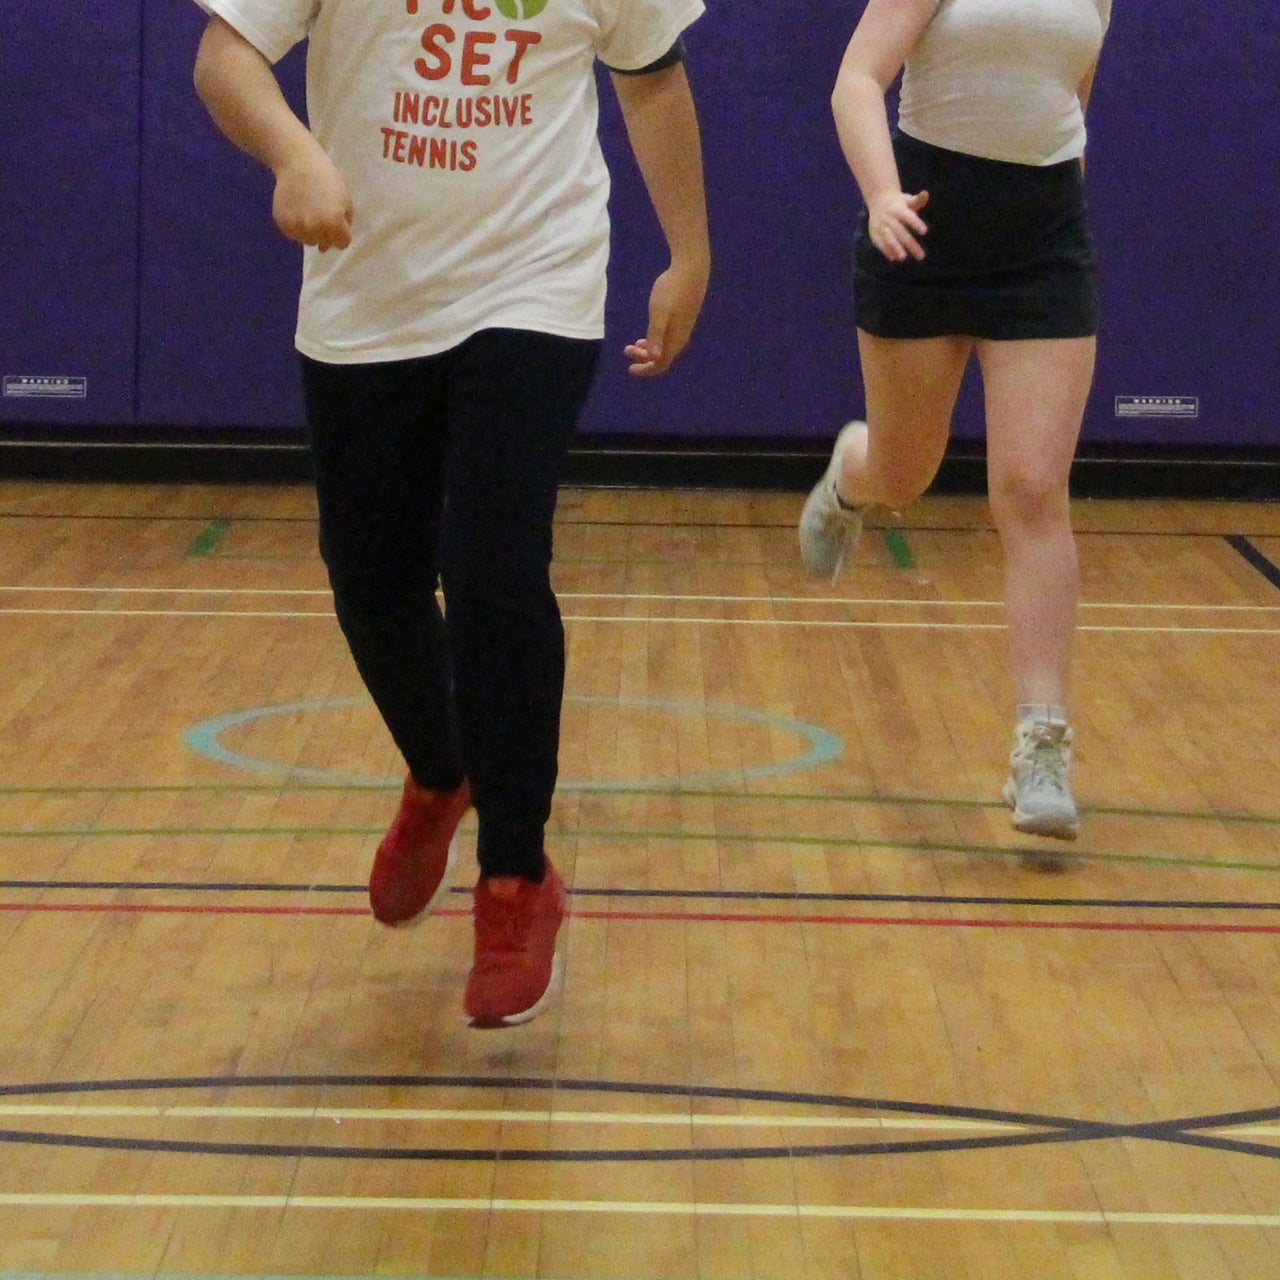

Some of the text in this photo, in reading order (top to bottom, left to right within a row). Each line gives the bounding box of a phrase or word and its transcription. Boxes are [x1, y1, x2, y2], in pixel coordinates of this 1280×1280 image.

[414, 23, 542, 86] SET
[393, 91, 533, 129] INCLUSIVE
[380, 127, 477, 172] TENNIS
